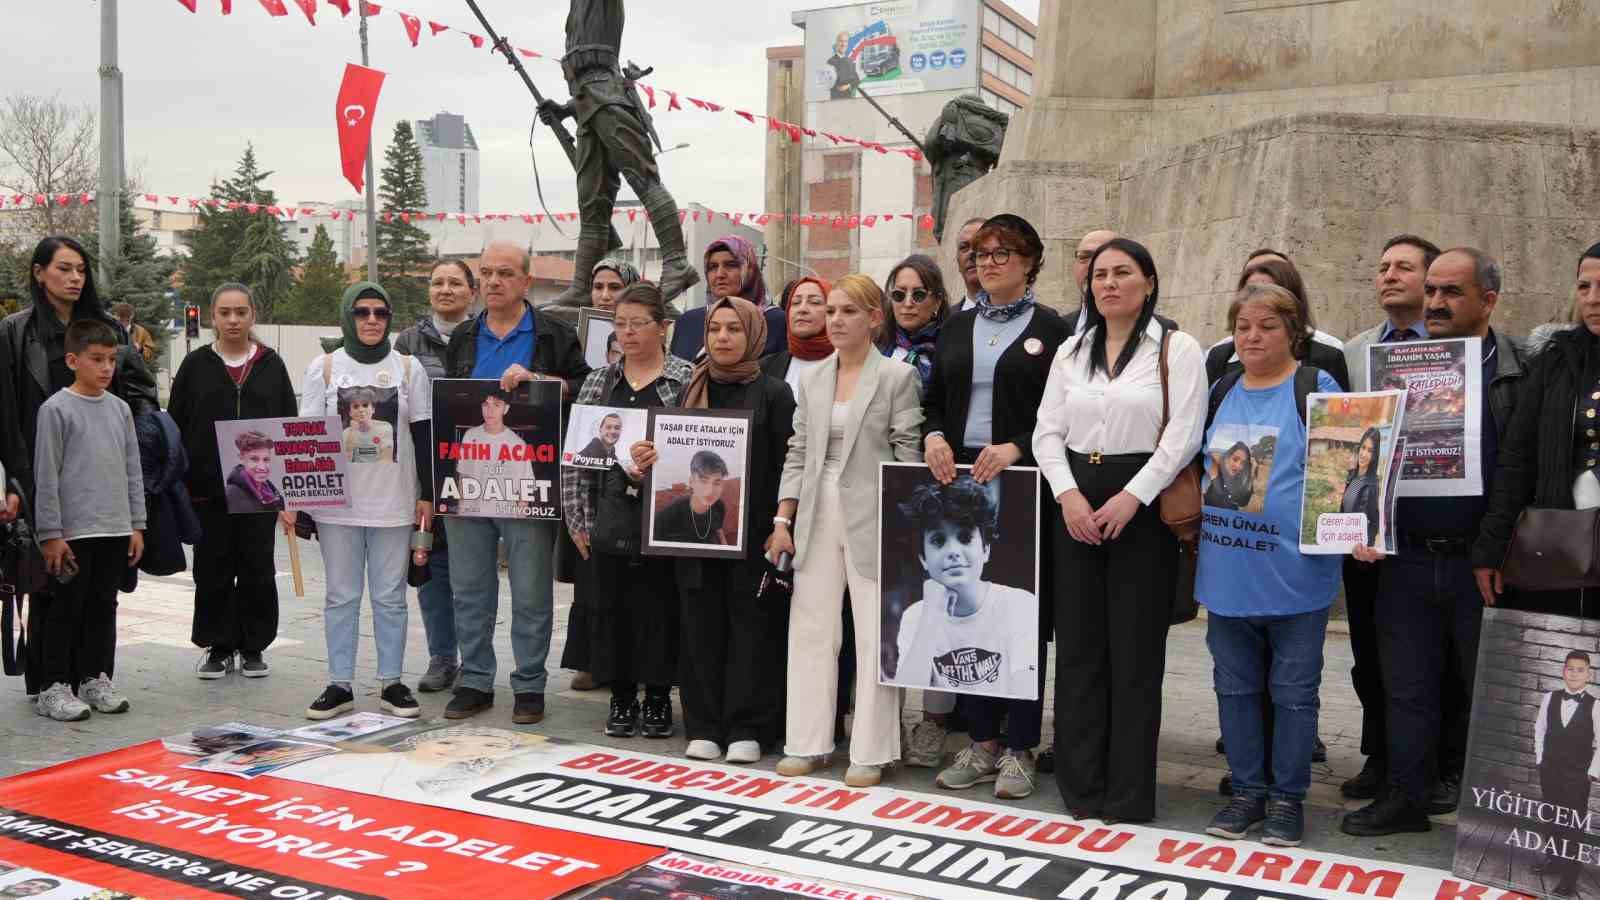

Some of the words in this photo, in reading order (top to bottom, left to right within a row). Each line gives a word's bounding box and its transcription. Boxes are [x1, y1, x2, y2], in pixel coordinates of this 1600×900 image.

[1387, 353, 1423, 362] İBRAHİM
[1424, 352, 1452, 361] YAŞAR
[660, 423, 683, 432] YAŞAR
[684, 424, 698, 433] EFE
[700, 424, 727, 434] ATALAY
[729, 426, 744, 436] İÇİN
[439, 442, 490, 462] FATİH
[667, 437, 695, 446] ADALET
[696, 437, 735, 448] İSTİYORUZ
[575, 455, 605, 466] Poyraz
[282, 473, 345, 490] ADALET
[440, 477, 552, 502] ADALET
[284, 489, 306, 498] HALA
[1232, 516, 1280, 536] ÜNAL
[951, 648, 978, 666] VANS
[955, 664, 976, 682] THE
[976, 653, 1000, 679] WALL
[1471, 786, 1593, 833] YİĞİTCEM
[101, 768, 270, 808] SAMET
[255, 796, 376, 833] İÇİN
[364, 824, 601, 877] ADELET
[560, 752, 870, 812] BURÇİN'İN
[871, 796, 1136, 853] UMUDU
[1154, 838, 1405, 899] YARIM
[111, 799, 389, 870] İSTİYORUZ
[486, 778, 775, 839] ADALET
[768, 819, 1051, 890] YARIM
[0, 812, 84, 841] AMET
[208, 870, 275, 892] NE
